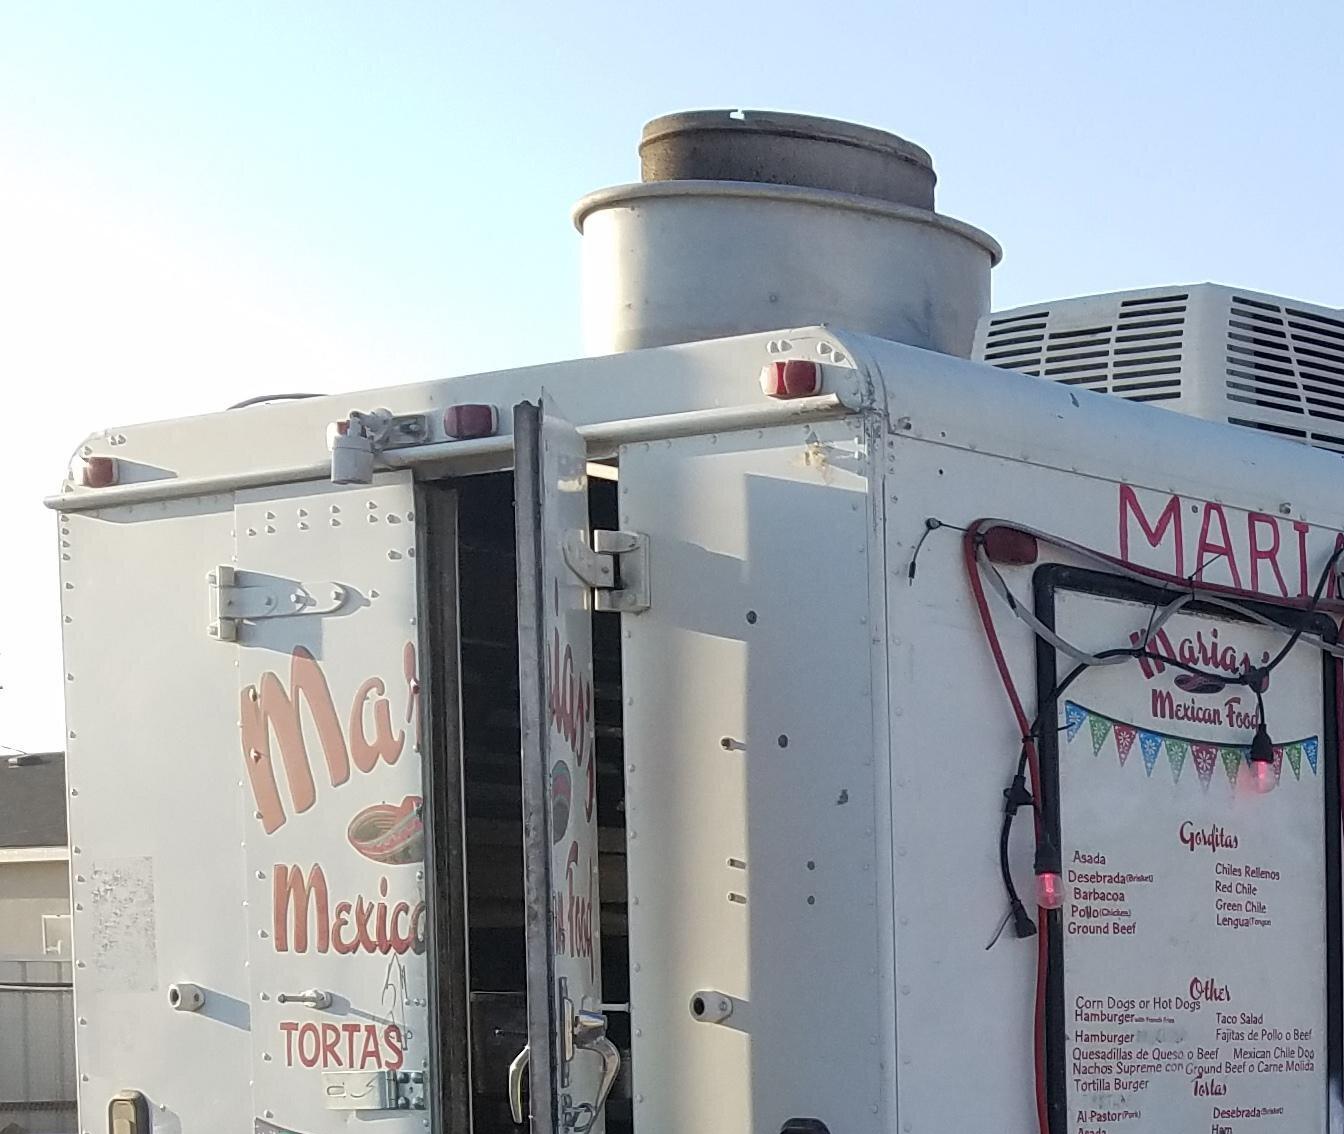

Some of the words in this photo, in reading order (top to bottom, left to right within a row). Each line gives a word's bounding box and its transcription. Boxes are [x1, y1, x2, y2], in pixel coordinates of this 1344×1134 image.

[1151, 688, 1223, 726] Mexican
[1225, 697, 1260, 730] Food
[1179, 820, 1239, 853] Gorditas
[1072, 850, 1106, 865] Asada
[1068, 870, 1126, 884] Desebrada
[1215, 862, 1242, 877] Chiles
[1244, 865, 1280, 880] Rellenos
[1073, 887, 1125, 902] Barbacoa
[1215, 880, 1233, 893] Red
[1235, 882, 1258, 896] Chile
[1071, 904, 1099, 919] Pollo
[1215, 898, 1242, 912] Green
[1245, 901, 1267, 914] Chile
[1068, 922, 1109, 935] Ground
[1112, 922, 1137, 935] Beef
[1216, 914, 1249, 929] Lengua
[1189, 976, 1231, 1002] Other
[1075, 996, 1103, 1010] Corn
[1107, 996, 1136, 1011] Dogs
[1138, 1000, 1150, 1009] or
[1153, 997, 1173, 1010] Hot
[1175, 997, 1201, 1012] Dogs
[1075, 1009, 1135, 1024] Hamburger
[1216, 1012, 1237, 1024] Taco
[1240, 1012, 1264, 1025] Salad
[1075, 1030, 1134, 1045] Hamburger
[1216, 1028, 1245, 1042] Fajitas
[1247, 1029, 1259, 1041] de
[1261, 1029, 1283, 1041] Pollo
[1293, 1028, 1312, 1041] Beef
[280, 1021, 404, 1071] TORTAS
[1233, 1047, 1271, 1059] Mexican
[1297, 1046, 1315, 1060] Dog
[1072, 1047, 1133, 1061] Quesadillas
[1136, 1048, 1149, 1060] de
[1152, 1047, 1184, 1061] Queso
[1187, 1050, 1194, 1060] o
[1197, 1047, 1219, 1060] Beef
[1072, 1062, 1113, 1075] Nachos
[1116, 1062, 1162, 1076] Supreme
[1165, 1063, 1184, 1072] con
[1185, 1062, 1222, 1075] Ground
[1224, 1061, 1246, 1074] Beef
[1248, 1064, 1255, 1073] o
[1257, 1060, 1284, 1073] Carne
[1285, 1060, 1315, 1072] Molida
[1073, 1078, 1111, 1092] Tortilla
[1114, 1077, 1150, 1092] Burger
[1077, 1110, 1087, 1123] Al
[1090, 1110, 1121, 1122] Pastor
[1213, 1106, 1260, 1119] Desebrada
